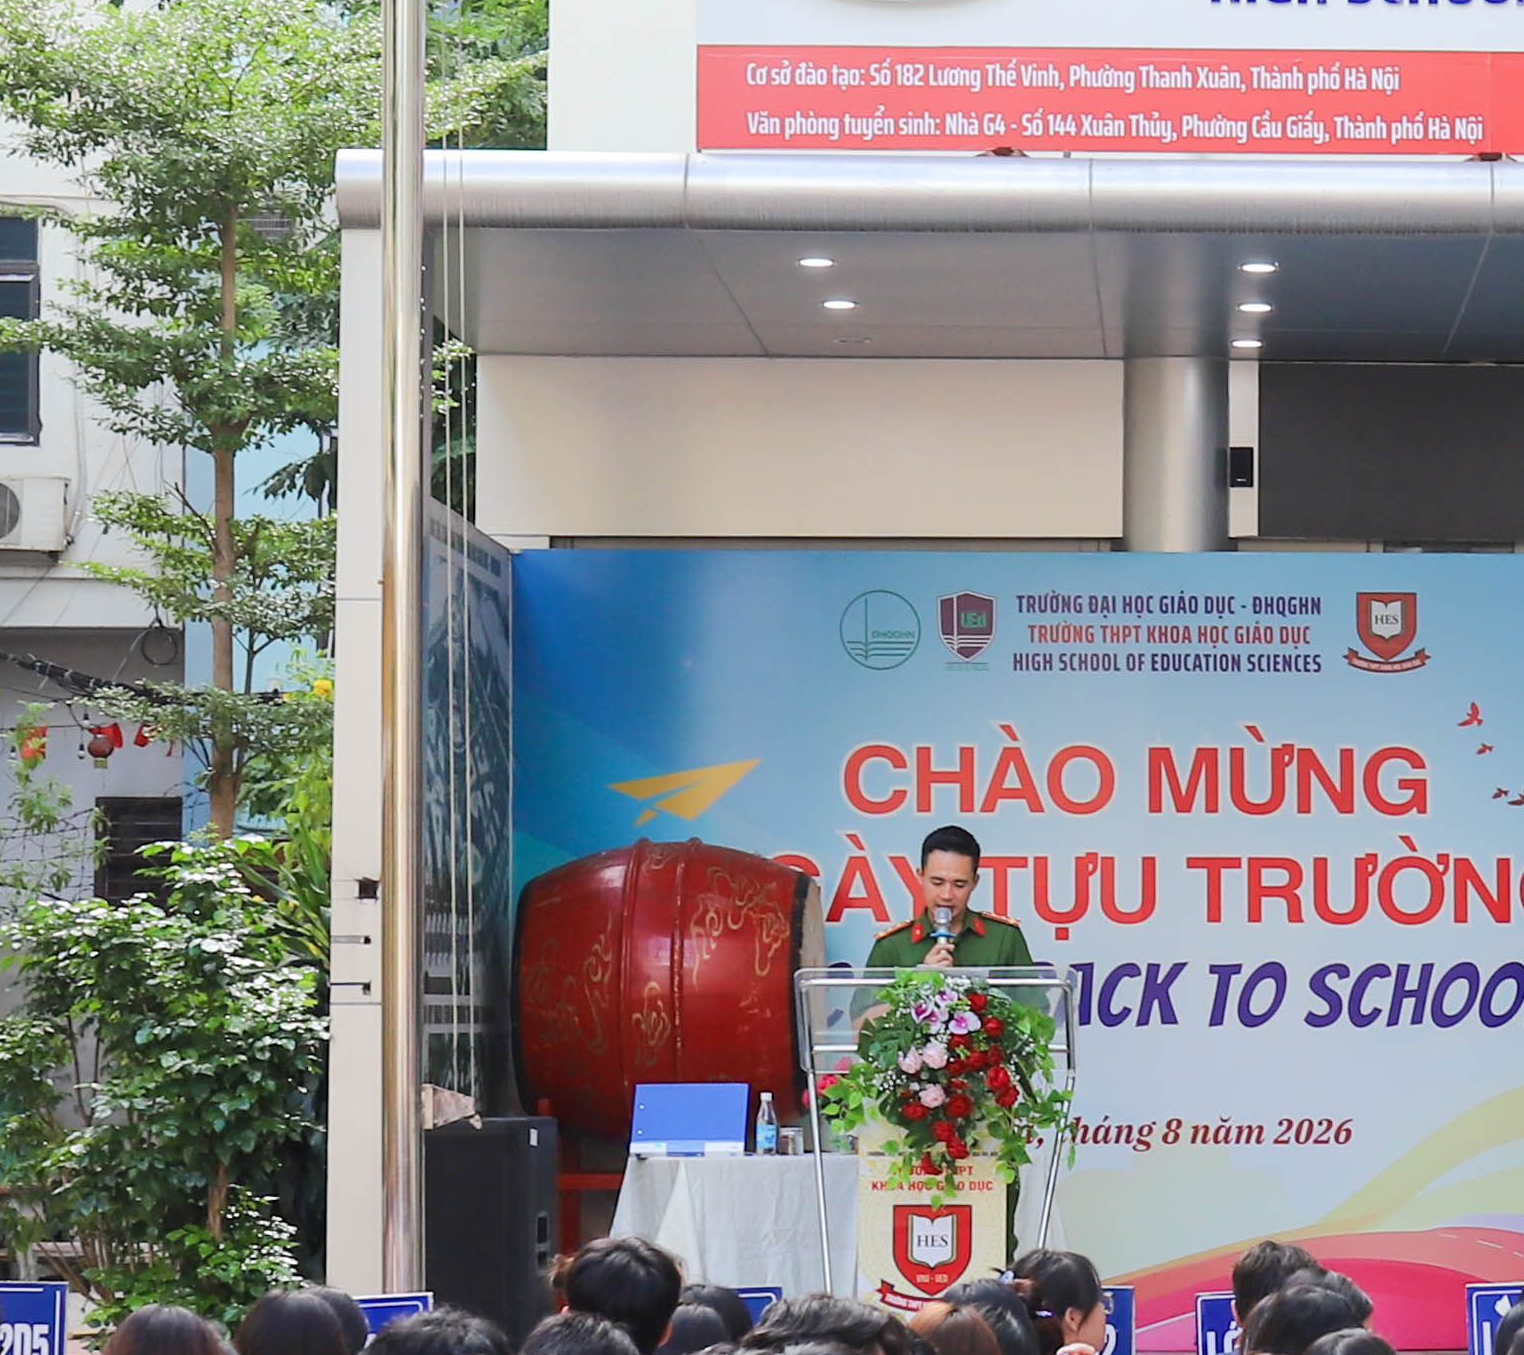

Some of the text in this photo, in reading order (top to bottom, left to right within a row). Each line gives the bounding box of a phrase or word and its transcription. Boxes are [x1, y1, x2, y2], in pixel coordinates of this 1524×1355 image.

[746, 57, 1400, 95] Cơ sở đào tạo: Số 182 Lương Thế Vinh, Phường Thanh Xuân, Thành phố Hà Nội
[747, 104, 1483, 145] Văn phòng tuyển sinh: Nhà G4 Số 144 Xuân Thủy, Phường Cầu Giấy, Thành phố Hà Nội
[1015, 589, 1321, 619] TRƯỜNG ĐẠI HỌC GIÁO DỤC ĐHQGHN
[1374, 614, 1399, 625] HES
[1027, 619, 1311, 649] TRƯỜNG THPT KHOA HỌC GIÁO DỤC
[1012, 652, 1322, 673] HIGH SCHOOL OF EDUCATION SCIENCES
[844, 724, 1428, 816] CHÀO MỪNG
[979, 852, 1157, 941] TỰU
[1209, 962, 1287, 1028] TO
[1066, 1115, 1156, 1153] háng
[1162, 1119, 1182, 1144] 8
[1191, 1118, 1264, 1144] năm
[1273, 1119, 1352, 1144] 2026
[917, 1235, 949, 1247] HES
